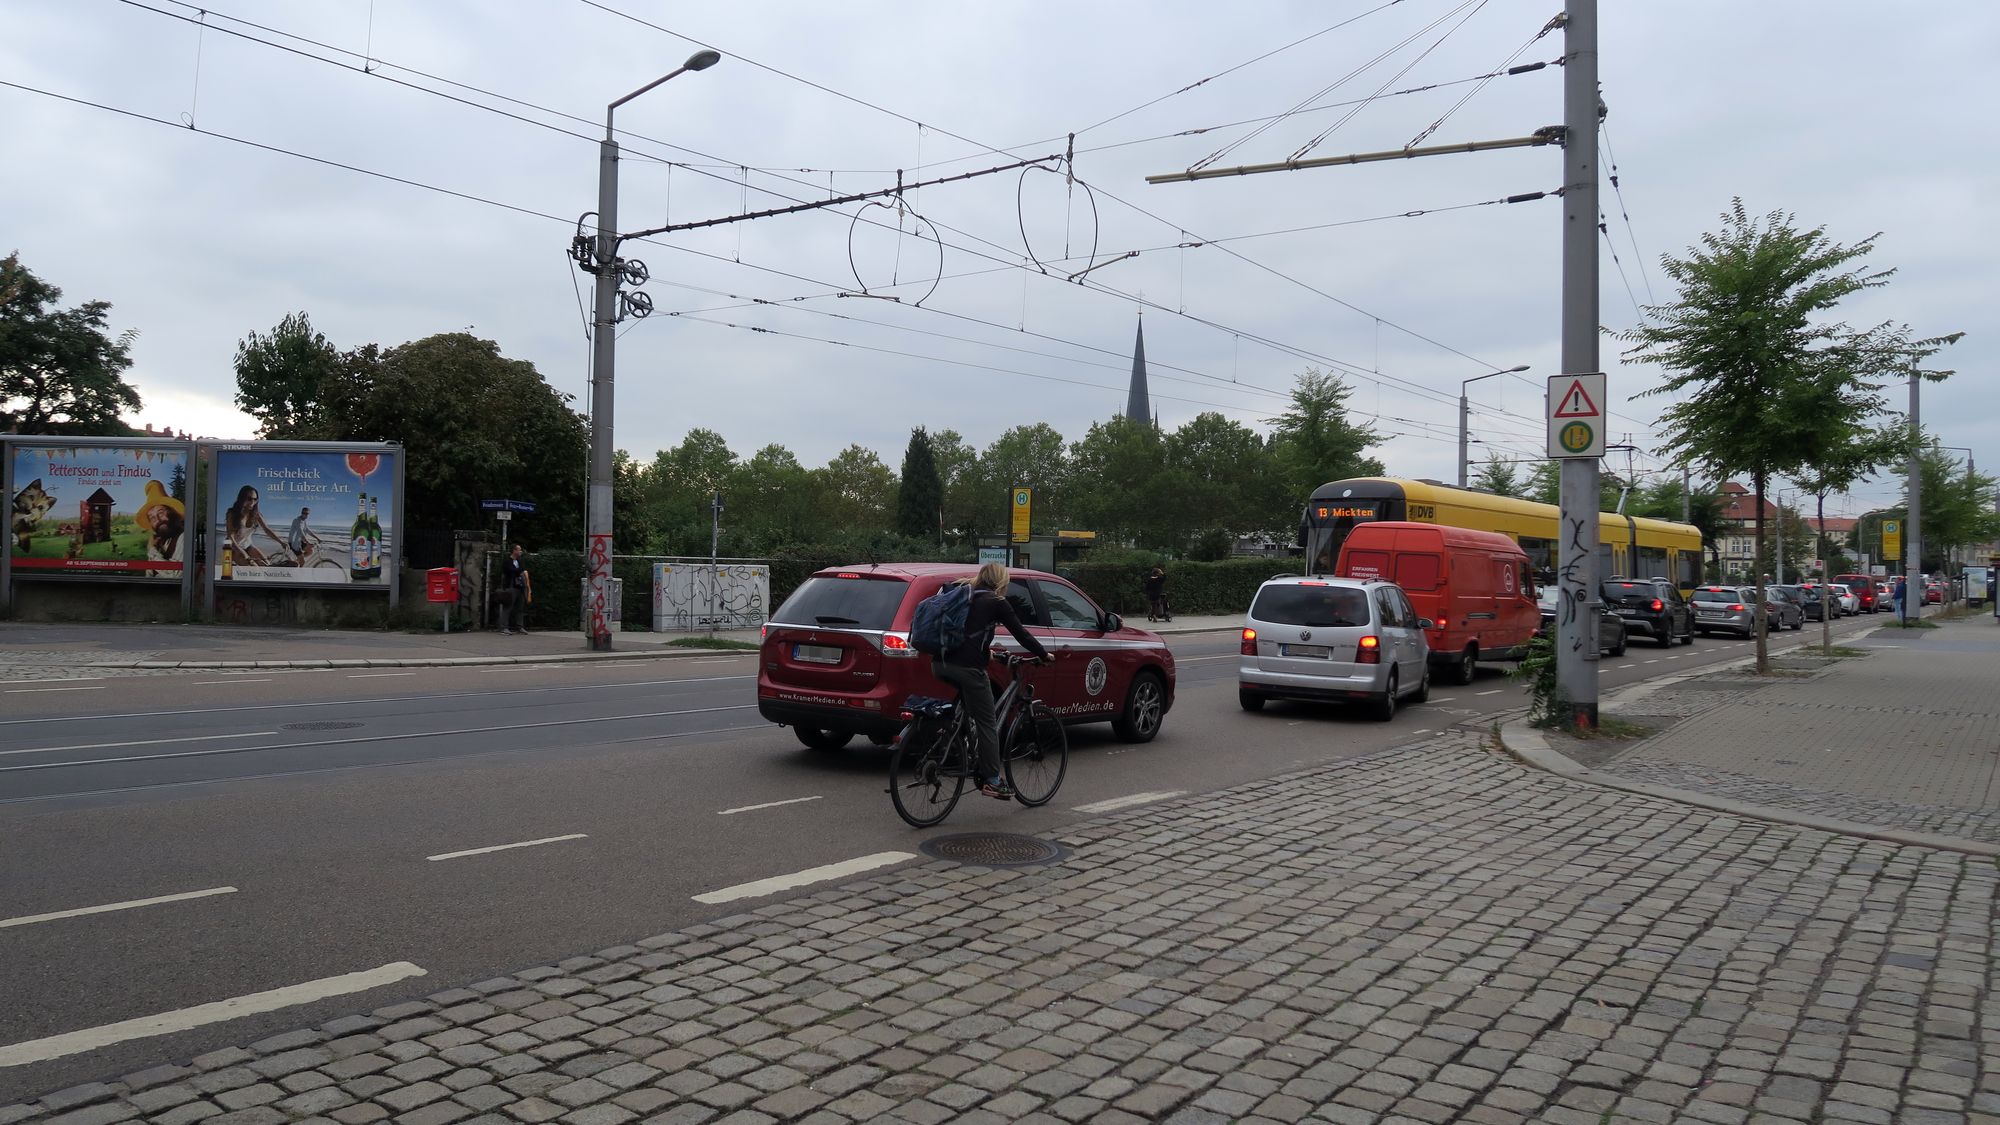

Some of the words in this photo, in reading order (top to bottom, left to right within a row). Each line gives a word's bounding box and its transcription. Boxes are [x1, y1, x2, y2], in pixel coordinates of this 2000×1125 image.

[48, 463, 99, 477] Pettersson
[102, 468, 115, 477] und
[117, 464, 152, 478] Findus
[257, 467, 321, 479] Frischekick
[266, 480, 286, 491] auf
[290, 481, 327, 492] Lübzer
[330, 483, 351, 493] Art.
[1318, 507, 1328, 517] 13
[1333, 507, 1375, 518] Mickten
[1417, 504, 1434, 518] DVB
[779, 693, 846, 705] www.KramerMedien.de
